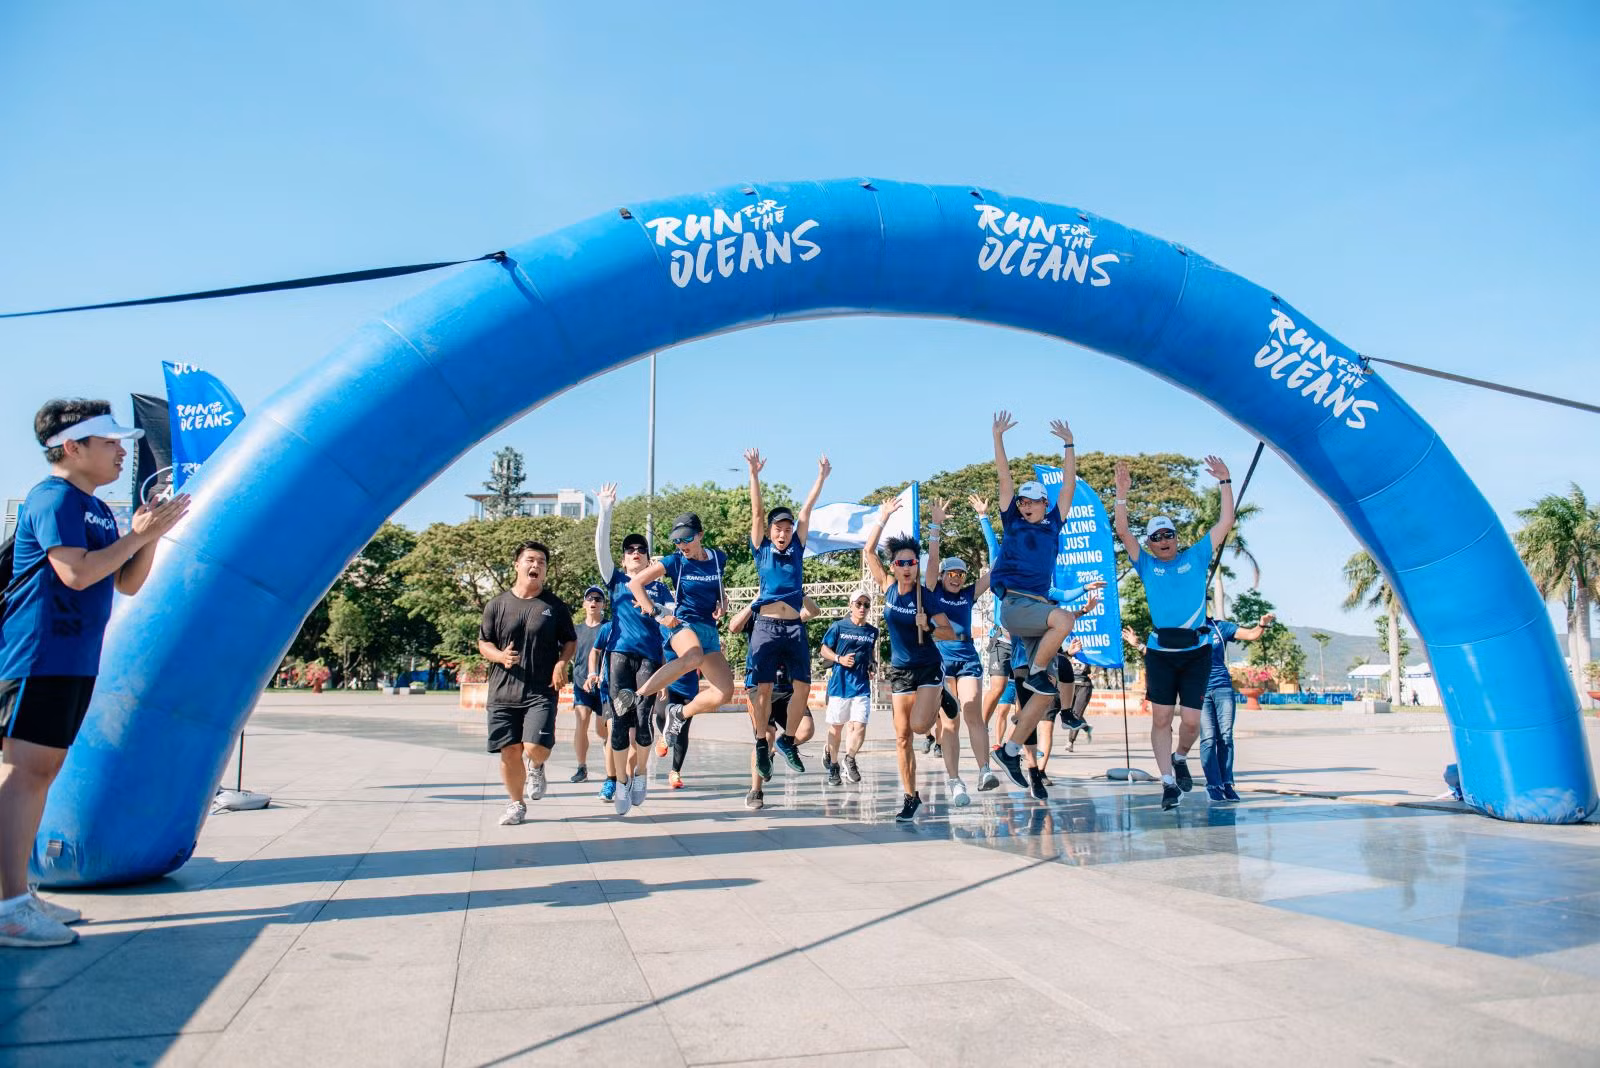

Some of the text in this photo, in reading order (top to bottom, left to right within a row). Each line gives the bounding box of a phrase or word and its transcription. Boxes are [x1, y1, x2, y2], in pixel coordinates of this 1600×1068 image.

[645, 199, 787, 247] RUN FOR THE
[973, 204, 1098, 250] RUN FOR THE
[670, 219, 822, 288] OCEANS
[978, 237, 1120, 287] OCEANS
[1269, 308, 1368, 388] RUN FOR THE
[1254, 339, 1379, 429] OCEANS
[176, 403, 208, 417] RUN
[181, 411, 234, 432] OCEANS
[1059, 520, 1097, 535] ALKING
[1064, 535, 1090, 550] JUST
[1056, 550, 1103, 565] RUNNING
[1072, 619, 1098, 633] JUST
